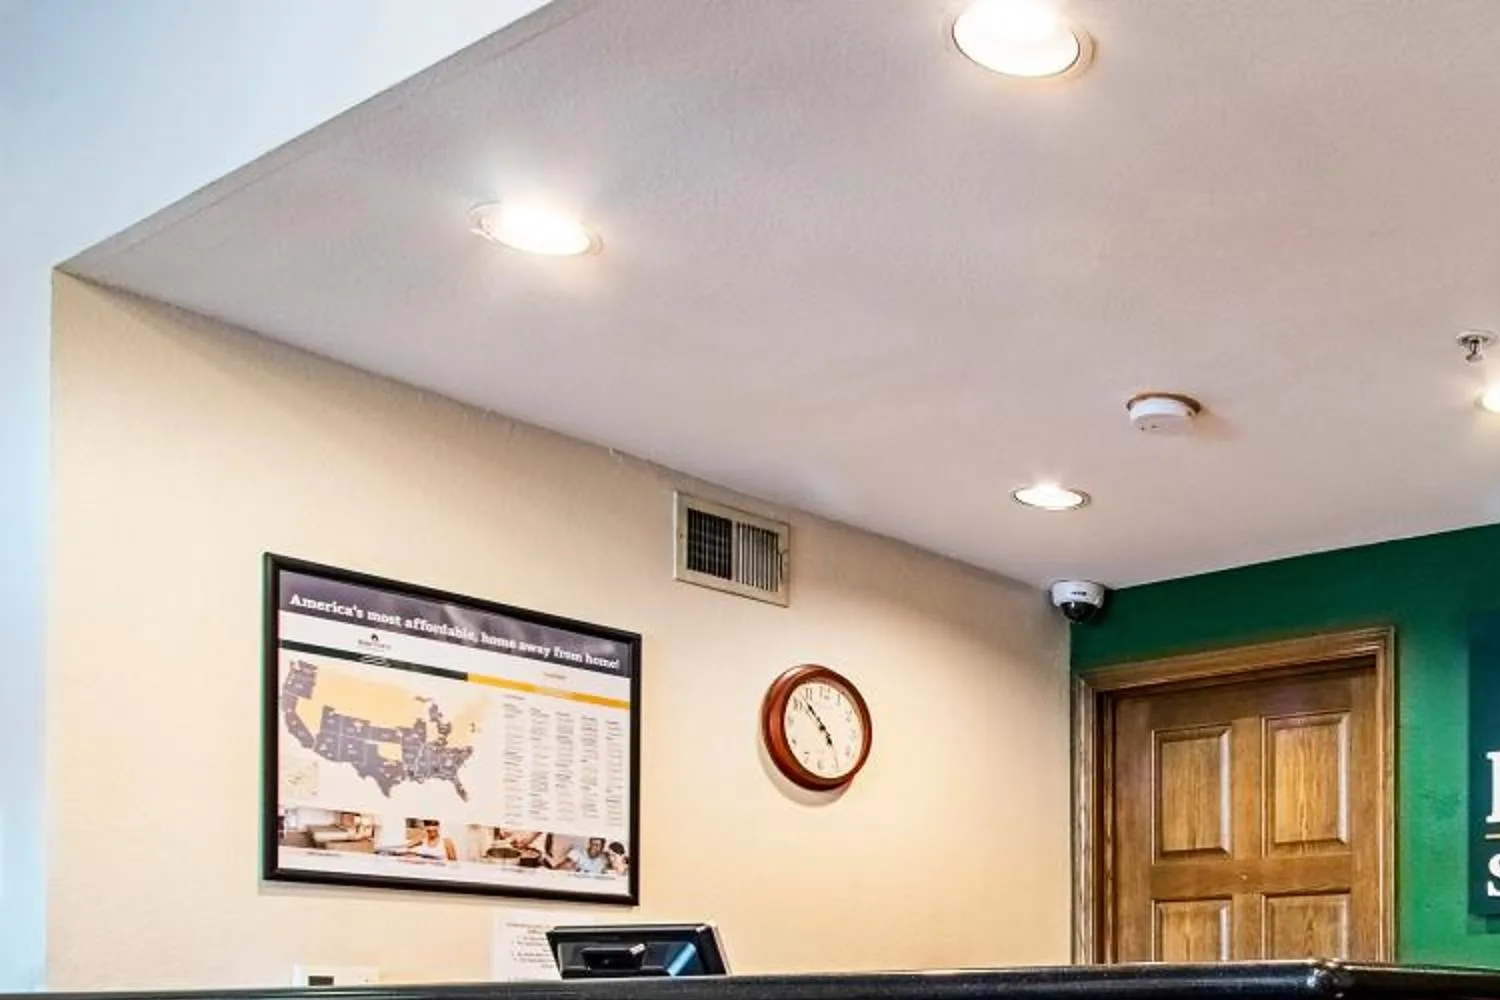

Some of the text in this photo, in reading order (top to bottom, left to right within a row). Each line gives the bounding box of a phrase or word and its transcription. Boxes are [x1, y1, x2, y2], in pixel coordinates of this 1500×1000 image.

[289, 593, 364, 619] America's
[367, 611, 402, 628] most
[480, 632, 517, 649] home
[519, 642, 551, 659] away
[553, 647, 583, 664] from
